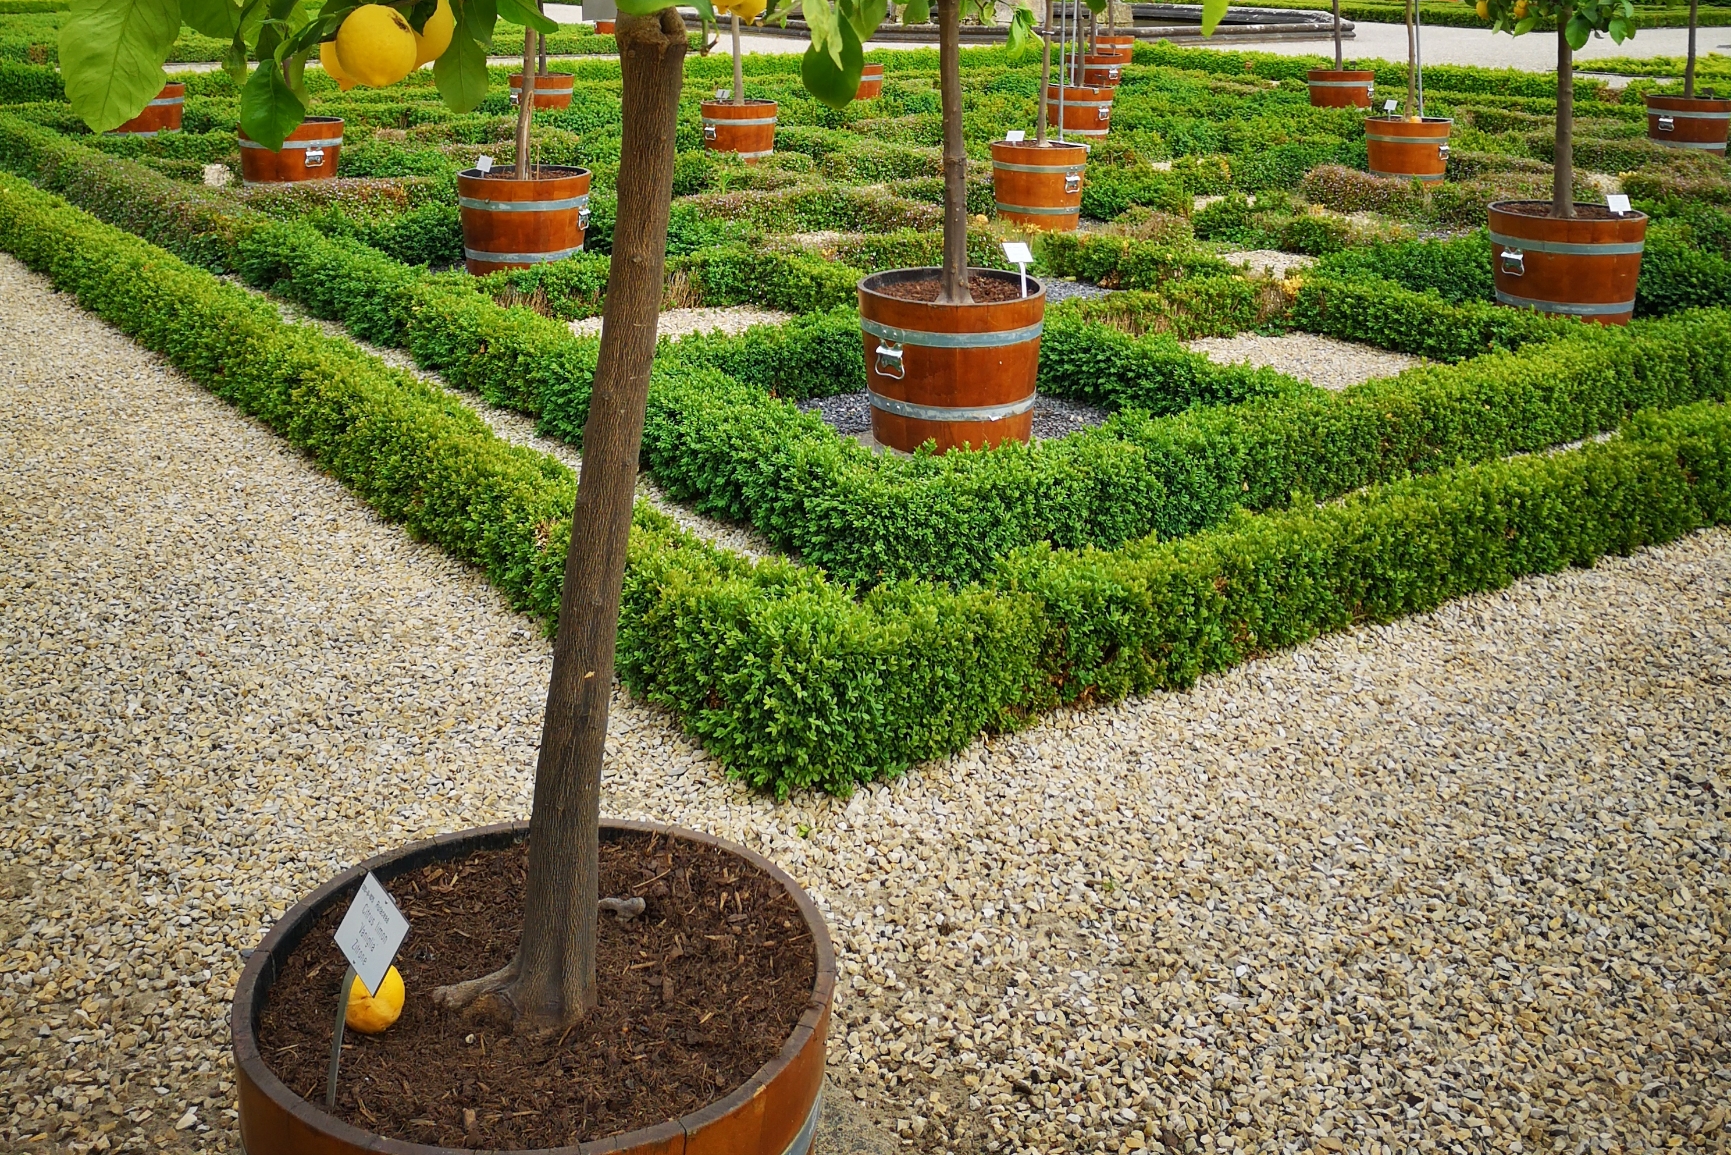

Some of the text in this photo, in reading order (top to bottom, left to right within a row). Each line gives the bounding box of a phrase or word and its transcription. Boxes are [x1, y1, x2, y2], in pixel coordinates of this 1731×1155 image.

[362, 903, 376, 926] Citrus
[374, 921, 388, 945] limon
[351, 938, 368, 966] Zitrone
